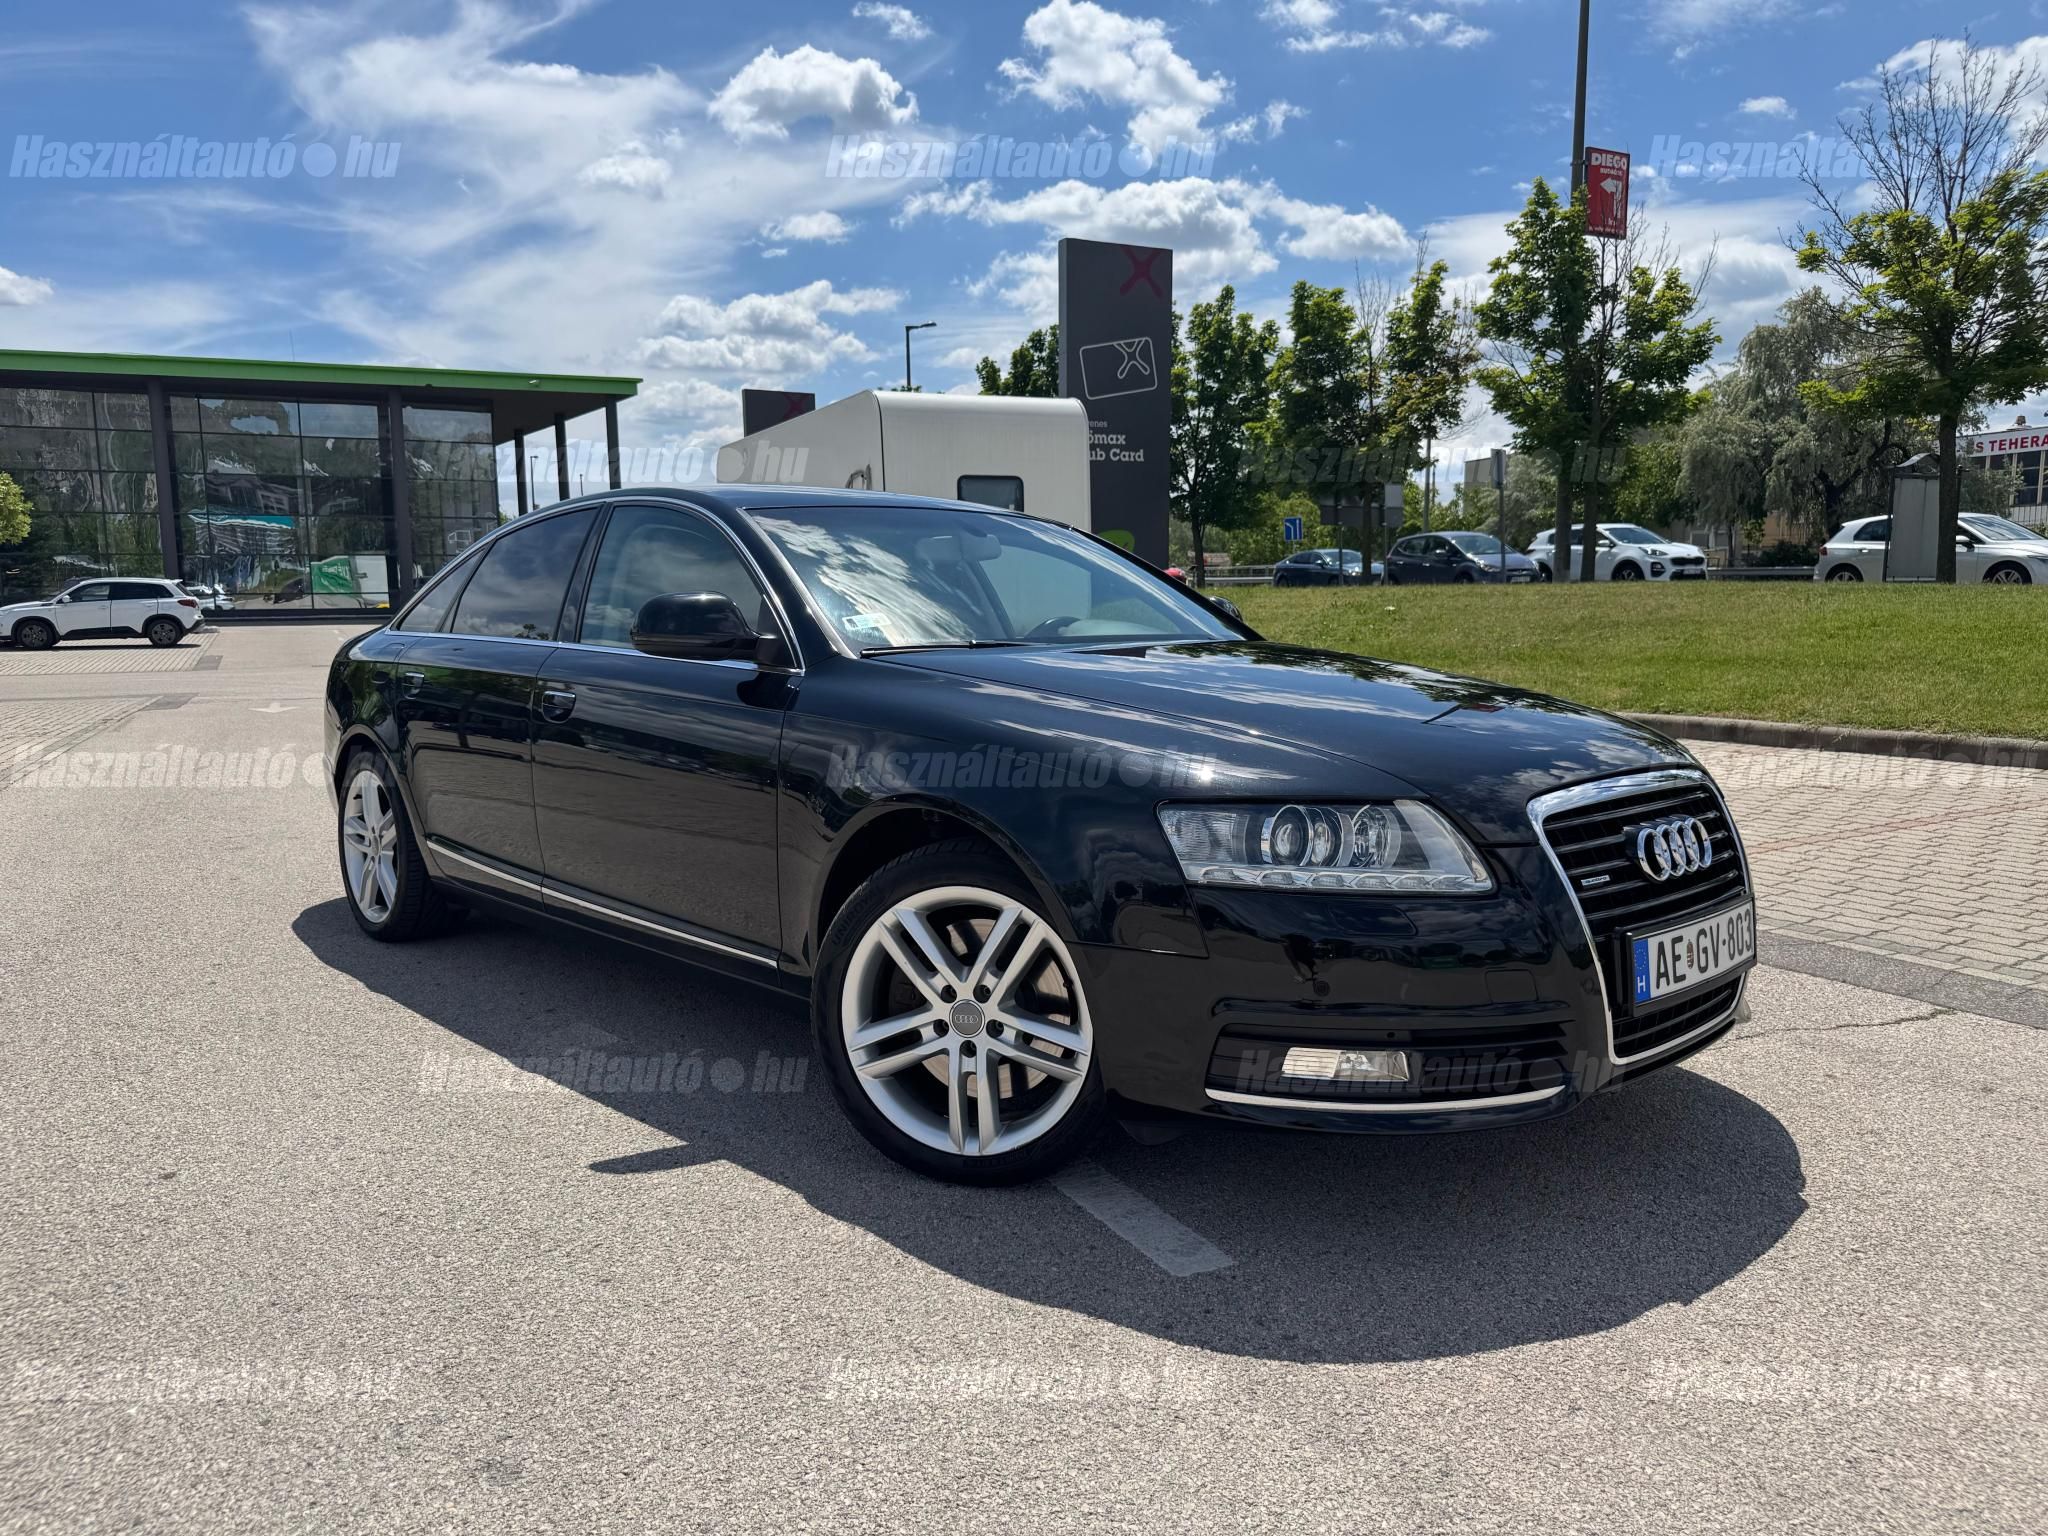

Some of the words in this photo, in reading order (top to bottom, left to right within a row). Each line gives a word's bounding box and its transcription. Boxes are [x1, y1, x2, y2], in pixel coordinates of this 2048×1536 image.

[1591, 152, 1628, 170] DIEGO
[1089, 429, 1126, 445] ömax
[1089, 447, 1106, 461] ub
[1109, 448, 1145, 462] Card
[1637, 976, 1646, 994] H
